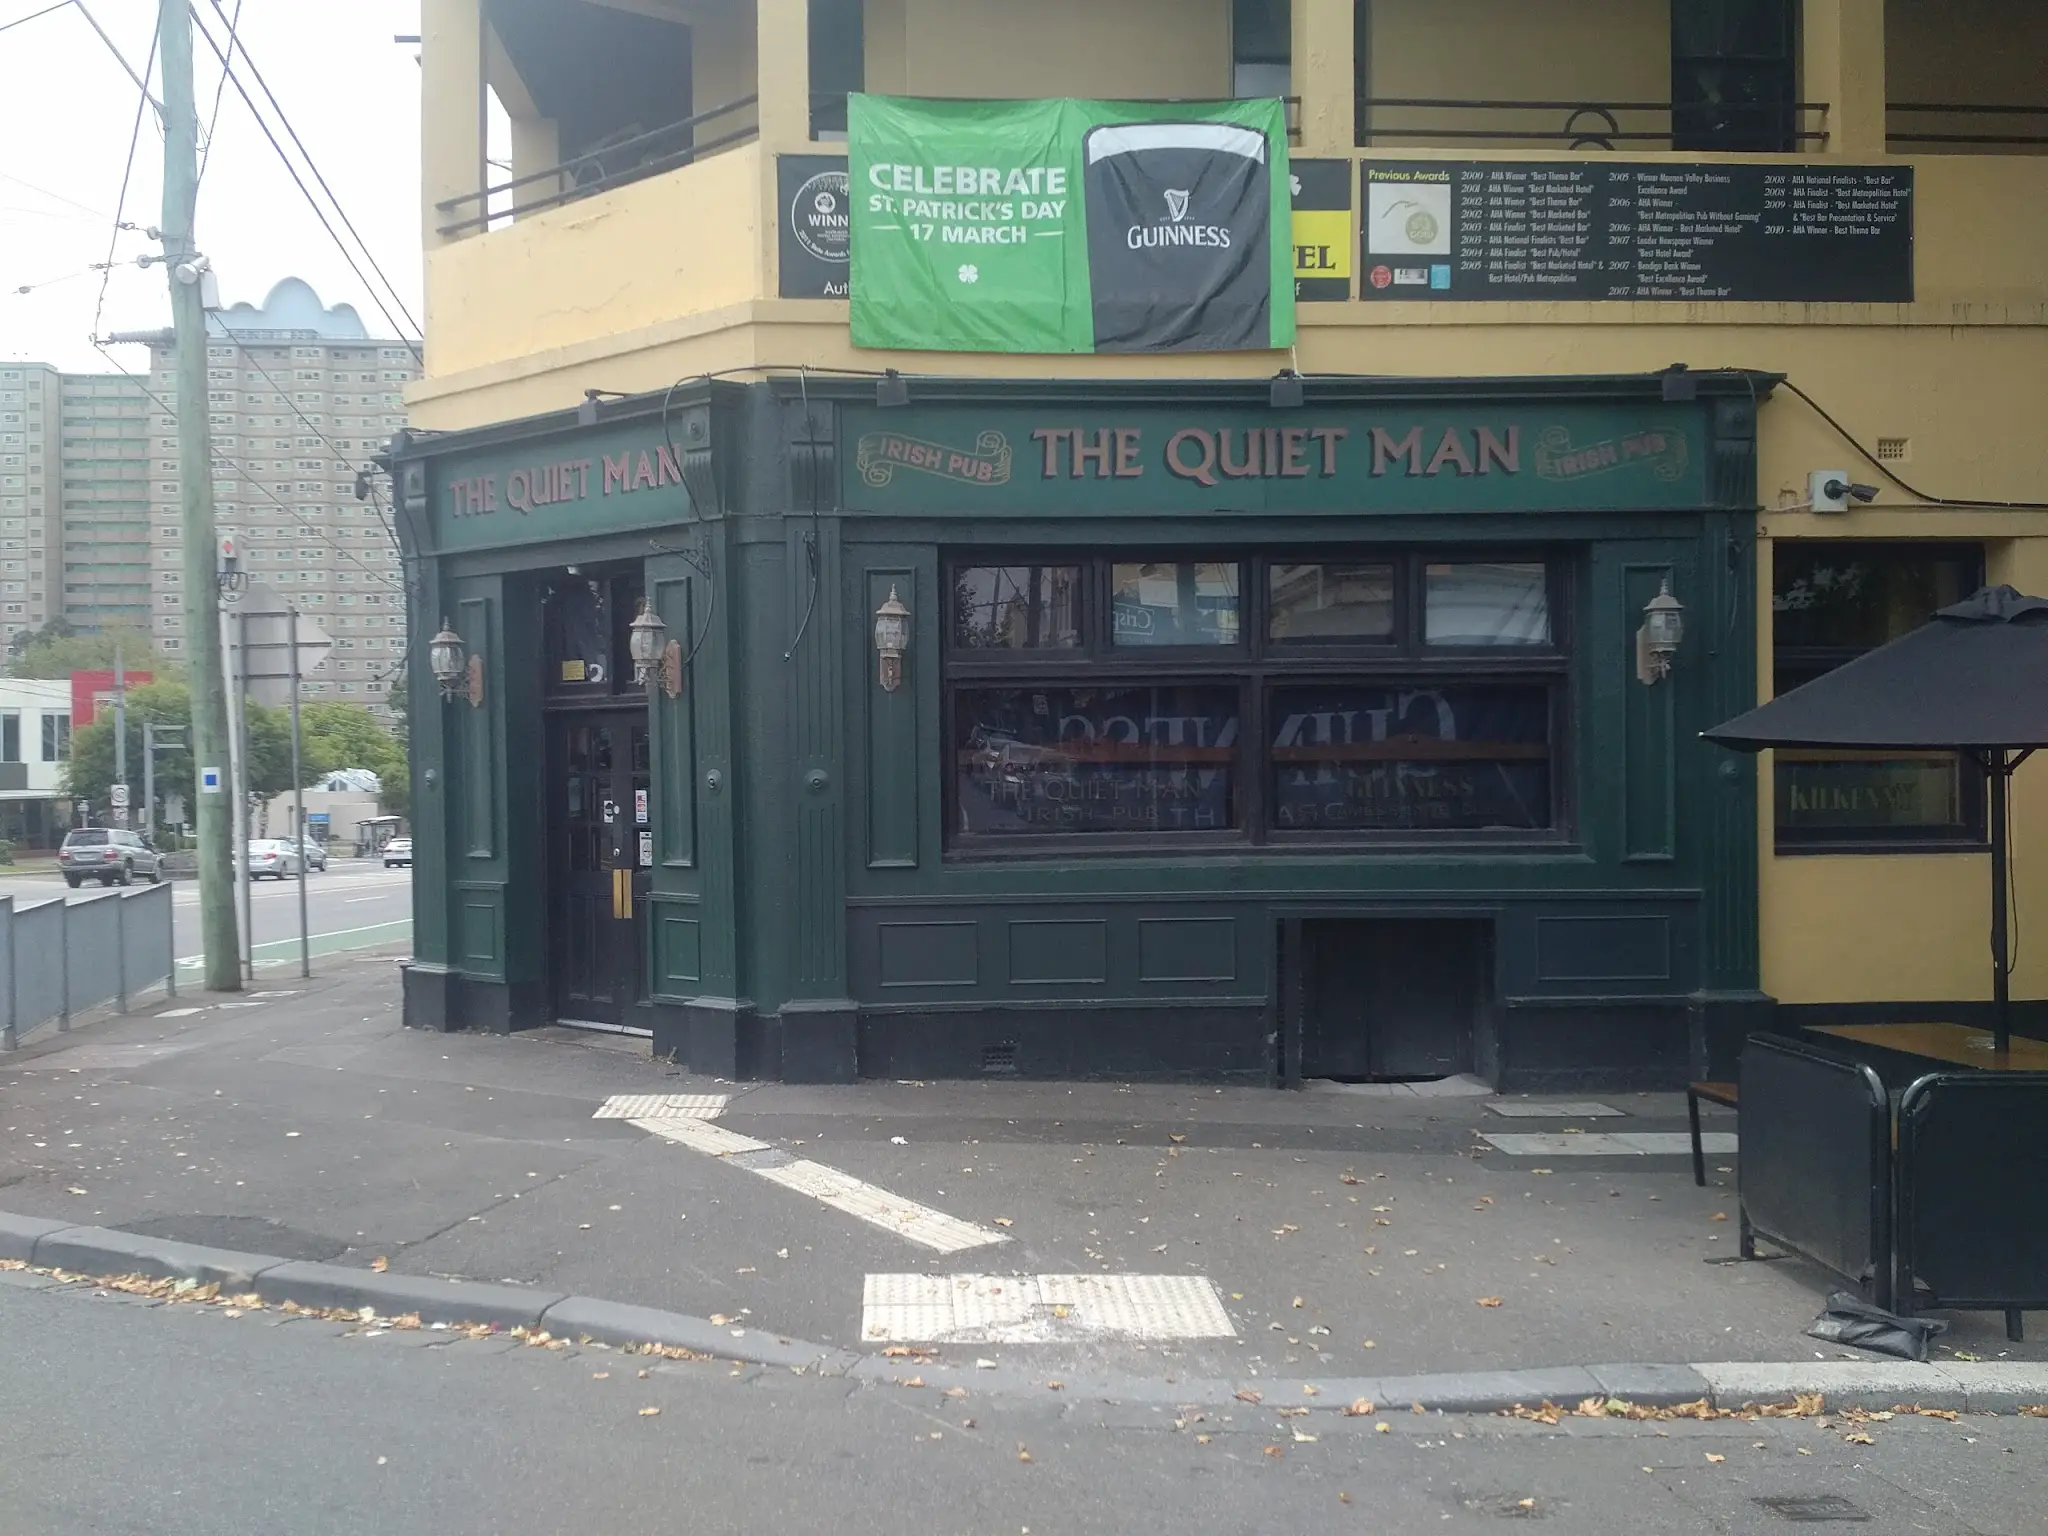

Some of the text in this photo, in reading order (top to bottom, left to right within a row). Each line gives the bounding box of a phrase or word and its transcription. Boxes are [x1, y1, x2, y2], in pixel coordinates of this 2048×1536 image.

[868, 164, 1066, 195] CELEBRATE
[1368, 169, 1450, 181] Previous Awards
[1505, 171, 1527, 180] Winner
[1637, 173, 1658, 182] Winner
[1685, 173, 1702, 184] Valley
[1704, 173, 1730, 182] Business
[1764, 176, 1785, 184] 2008
[1806, 176, 1831, 184] National
[1832, 176, 1857, 184] Finalists
[1503, 184, 1524, 193] Winner
[1638, 186, 1687, 195] Excellence Award
[1764, 188, 1785, 196] 2008
[1807, 188, 1828, 197] Finalist
[1504, 197, 1525, 206] Winner
[1652, 198, 1673, 207] Winner
[1764, 200, 1786, 208] 2009
[1807, 201, 1828, 209] Finalist
[869, 194, 1066, 221] ST. PATRICK'S DAY
[1504, 210, 1526, 218] Winner
[1697, 211, 1707, 220] Pub
[1709, 212, 1733, 221] Without
[1652, 224, 1673, 232] Winner
[1807, 226, 1827, 234] Winner
[1834, 226, 1848, 234] Best
[1870, 226, 1881, 234] Bar
[910, 224, 1027, 244] 17 MARCH
[1127, 225, 1231, 249] GUINNESS
[1608, 236, 1630, 244] 2007
[1693, 237, 1714, 245] Winner
[1293, 244, 1336, 270] EL
[1655, 249, 1672, 257] Hotel
[1680, 262, 1701, 270] Winner
[880, 436, 993, 482] IRISH PUB
[1032, 425, 1521, 487] THE QUIET MAN
[449, 443, 682, 517] THE QUIET MAN
[1045, 779, 1122, 802] QUIET
[1134, 779, 1202, 801] MAN
